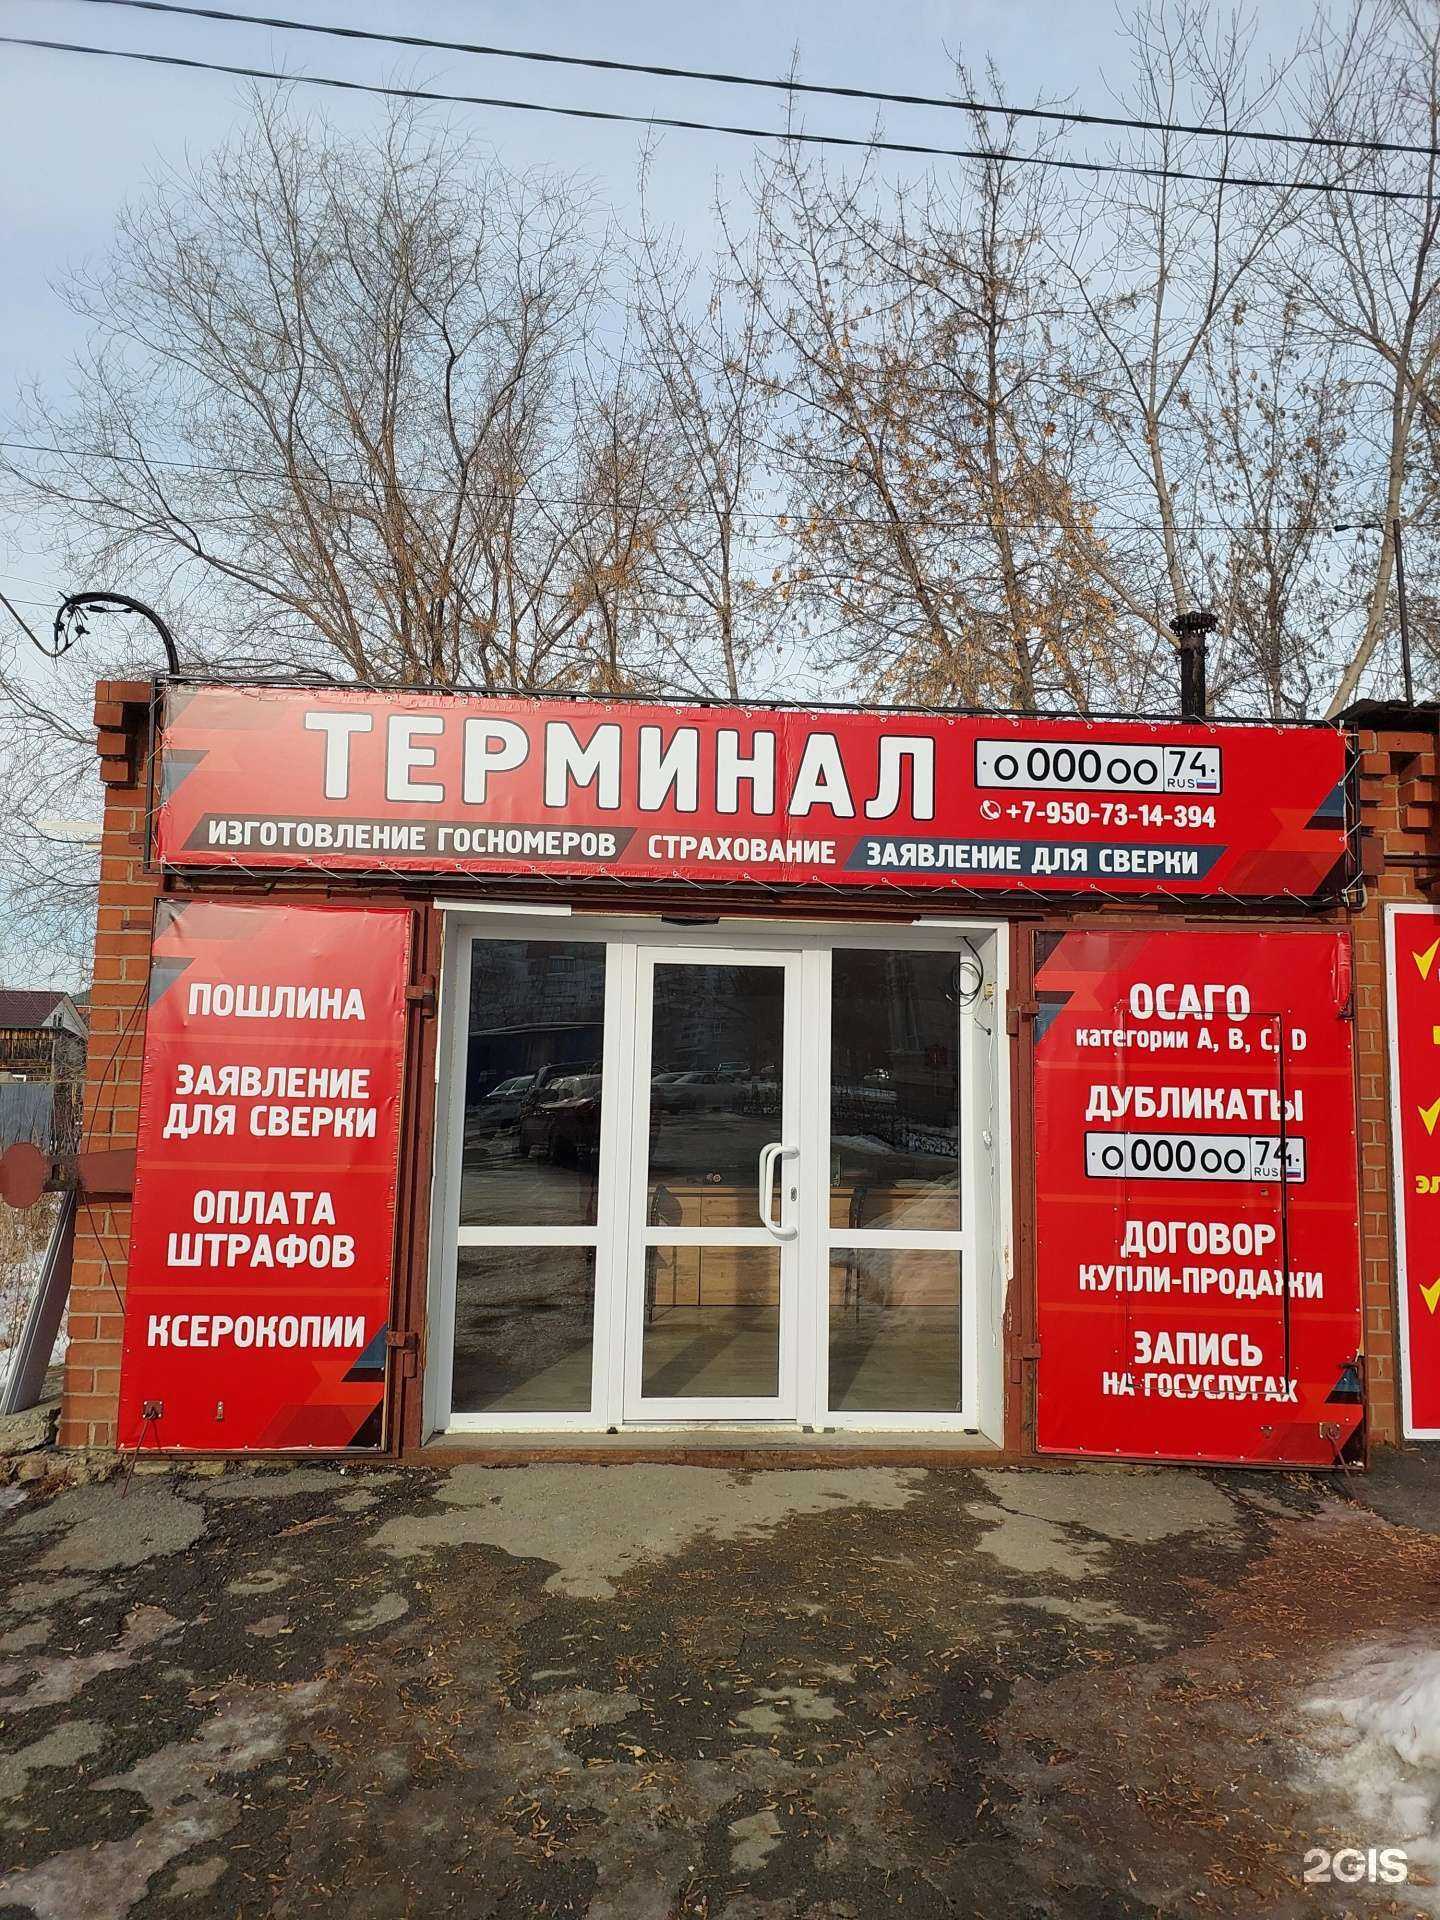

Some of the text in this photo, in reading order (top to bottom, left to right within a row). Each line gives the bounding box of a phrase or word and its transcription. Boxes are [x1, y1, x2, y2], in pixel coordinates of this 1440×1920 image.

[304, 711, 935, 821] ТЕРМИНАЛ
[1167, 778, 1195, 788] RUS
[1006, 801, 1216, 828] +7-950-73-14-394
[208, 820, 616, 857] ИЗГОТОВЛЕНИЕ ГОСНОМЕРОВ
[648, 834, 836, 864] СТРАХОВАНИЕ
[866, 842, 1198, 875] ЗАЯВЛЕНИЕ ДЛЯ СВЕРКИ
[187, 983, 366, 1021] ПОШЛИНА
[1129, 983, 1250, 1021] ОСАГО
[1076, 1028, 1188, 1052] категории
[1291, 1028, 1307, 1051] D
[175, 1064, 371, 1099] ЗАЯВЛЕНИЕ
[162, 1103, 377, 1139] ДЛЯ СВЕРКИ
[1085, 1085, 1304, 1122] ДУБЛИКАТЫ
[1254, 1167, 1279, 1178] RUS
[192, 1189, 337, 1226] ОПЛАТА
[166, 1233, 356, 1268] ШТРАФОВ
[1120, 1221, 1276, 1258] ДОГОВОР
[1079, 1264, 1324, 1300] КУПЛИ-ПРОДАЖИ
[147, 1314, 366, 1348] КСЕРОКОПИИ
[1134, 1330, 1264, 1367] ЗАПИСЬ
[1103, 1371, 1299, 1403] НА ГОСУСЛУГАХ
